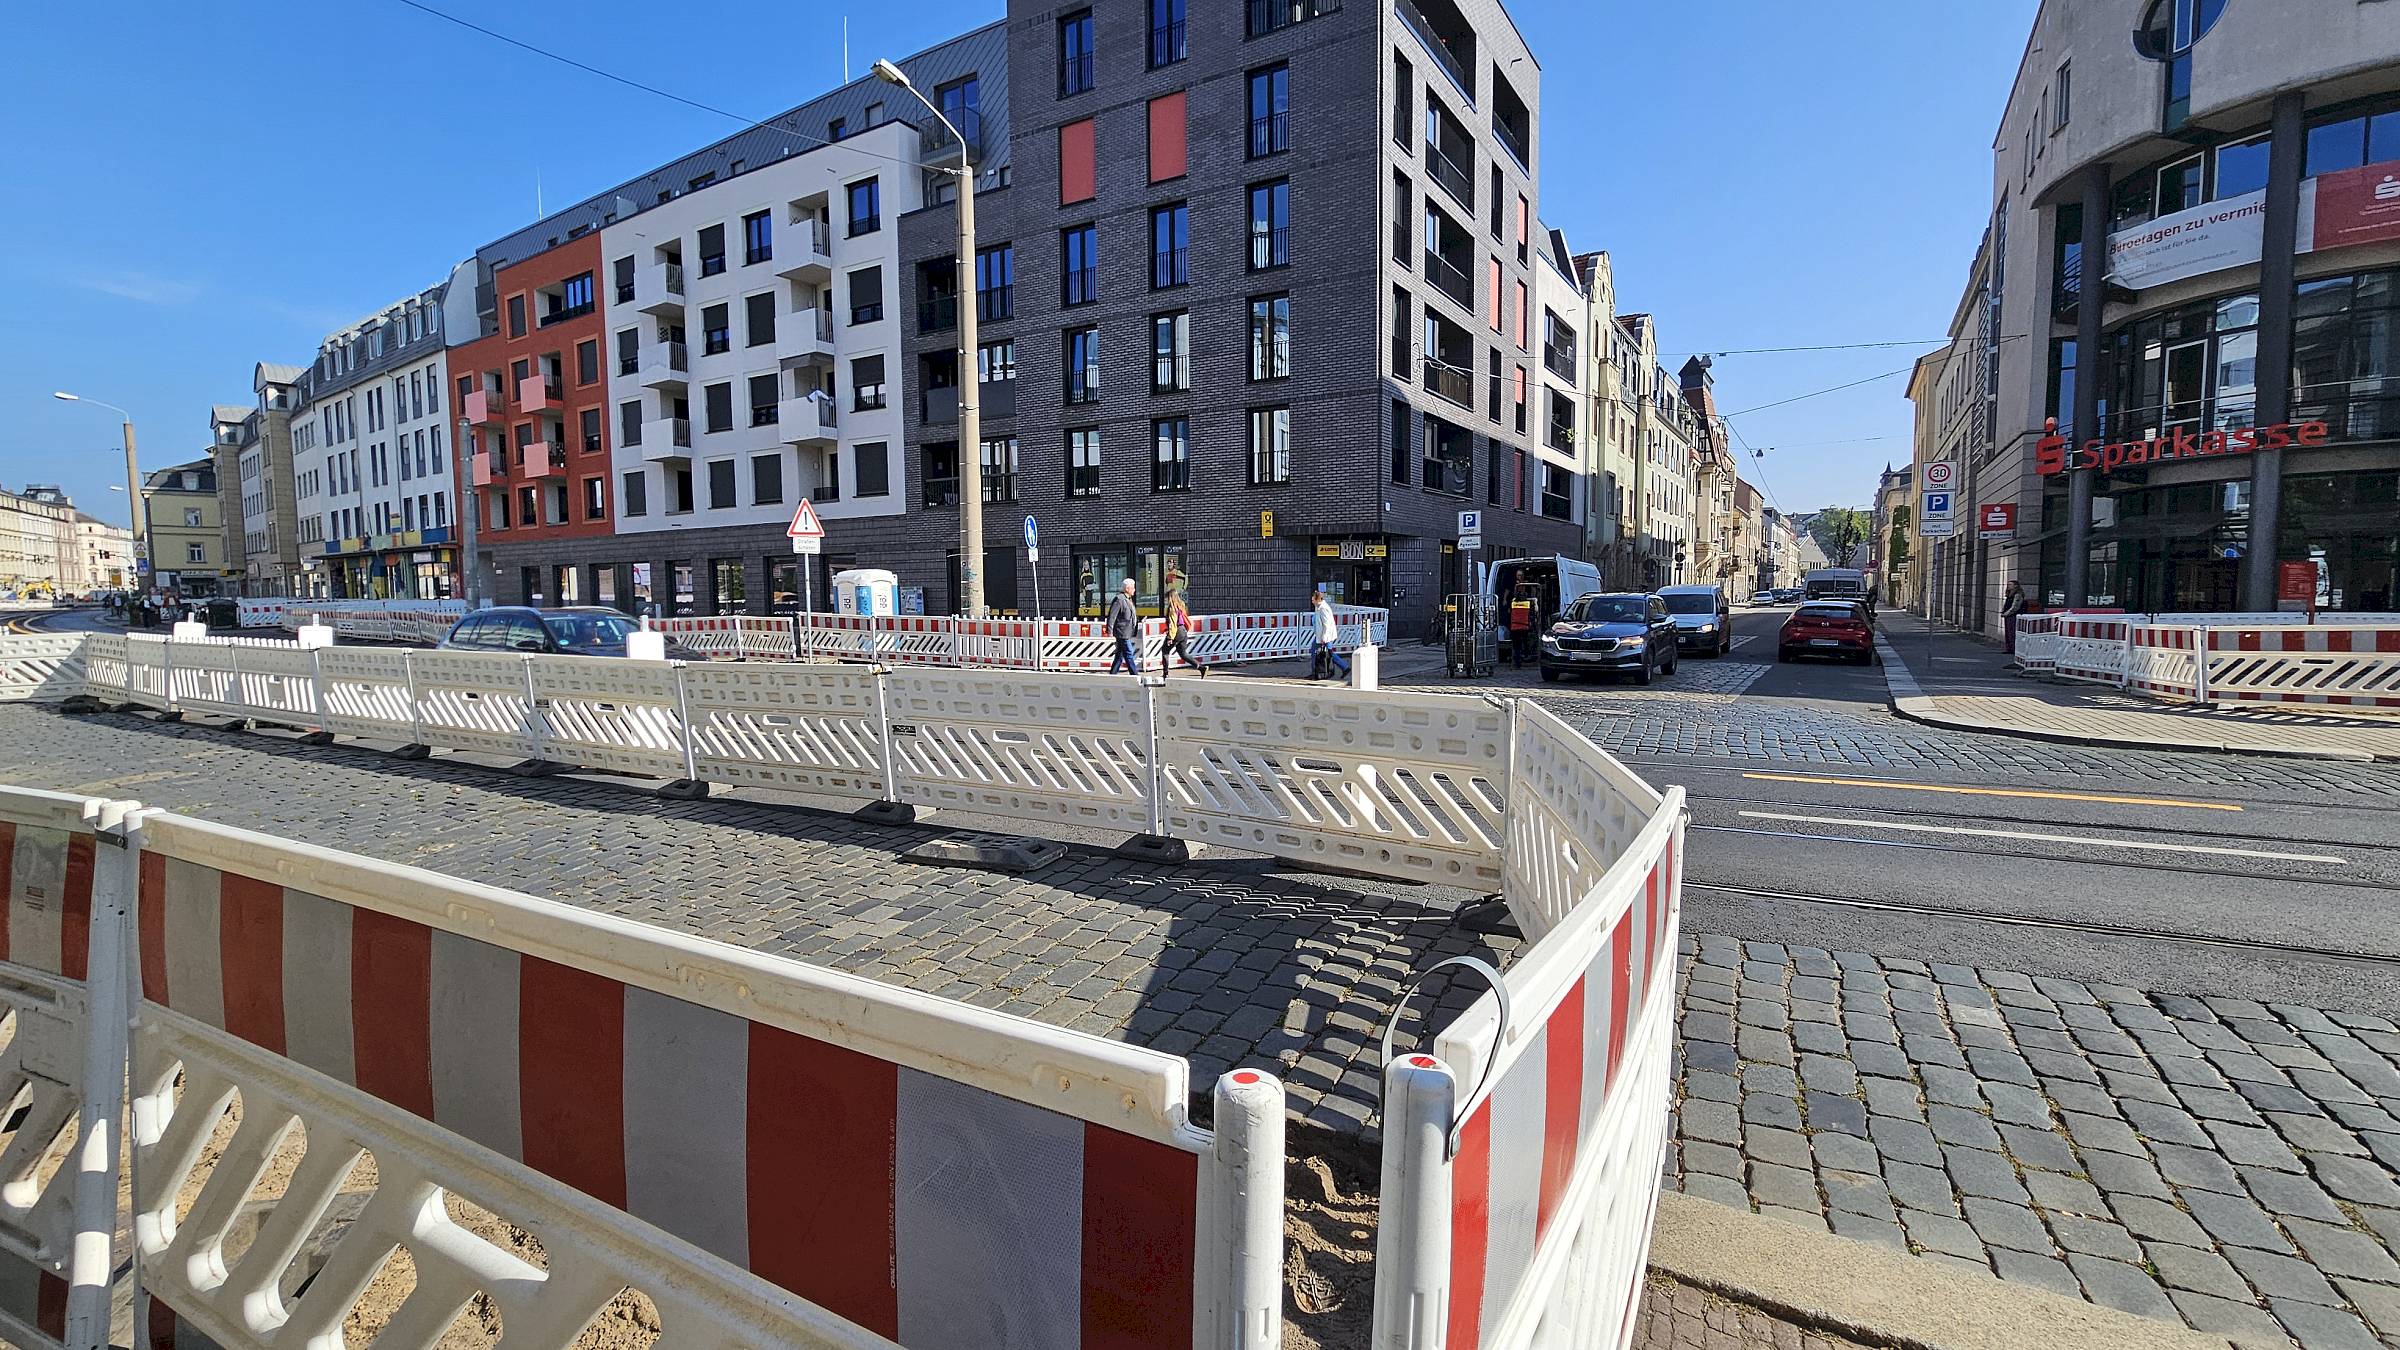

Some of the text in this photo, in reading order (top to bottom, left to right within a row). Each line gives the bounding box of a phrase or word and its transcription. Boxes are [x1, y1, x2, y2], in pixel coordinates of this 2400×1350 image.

[2185, 218, 2204, 231] zu
[2081, 420, 2328, 474] Sparkasse
[1932, 468, 1947, 478] 30
[1932, 496, 1944, 510] P
